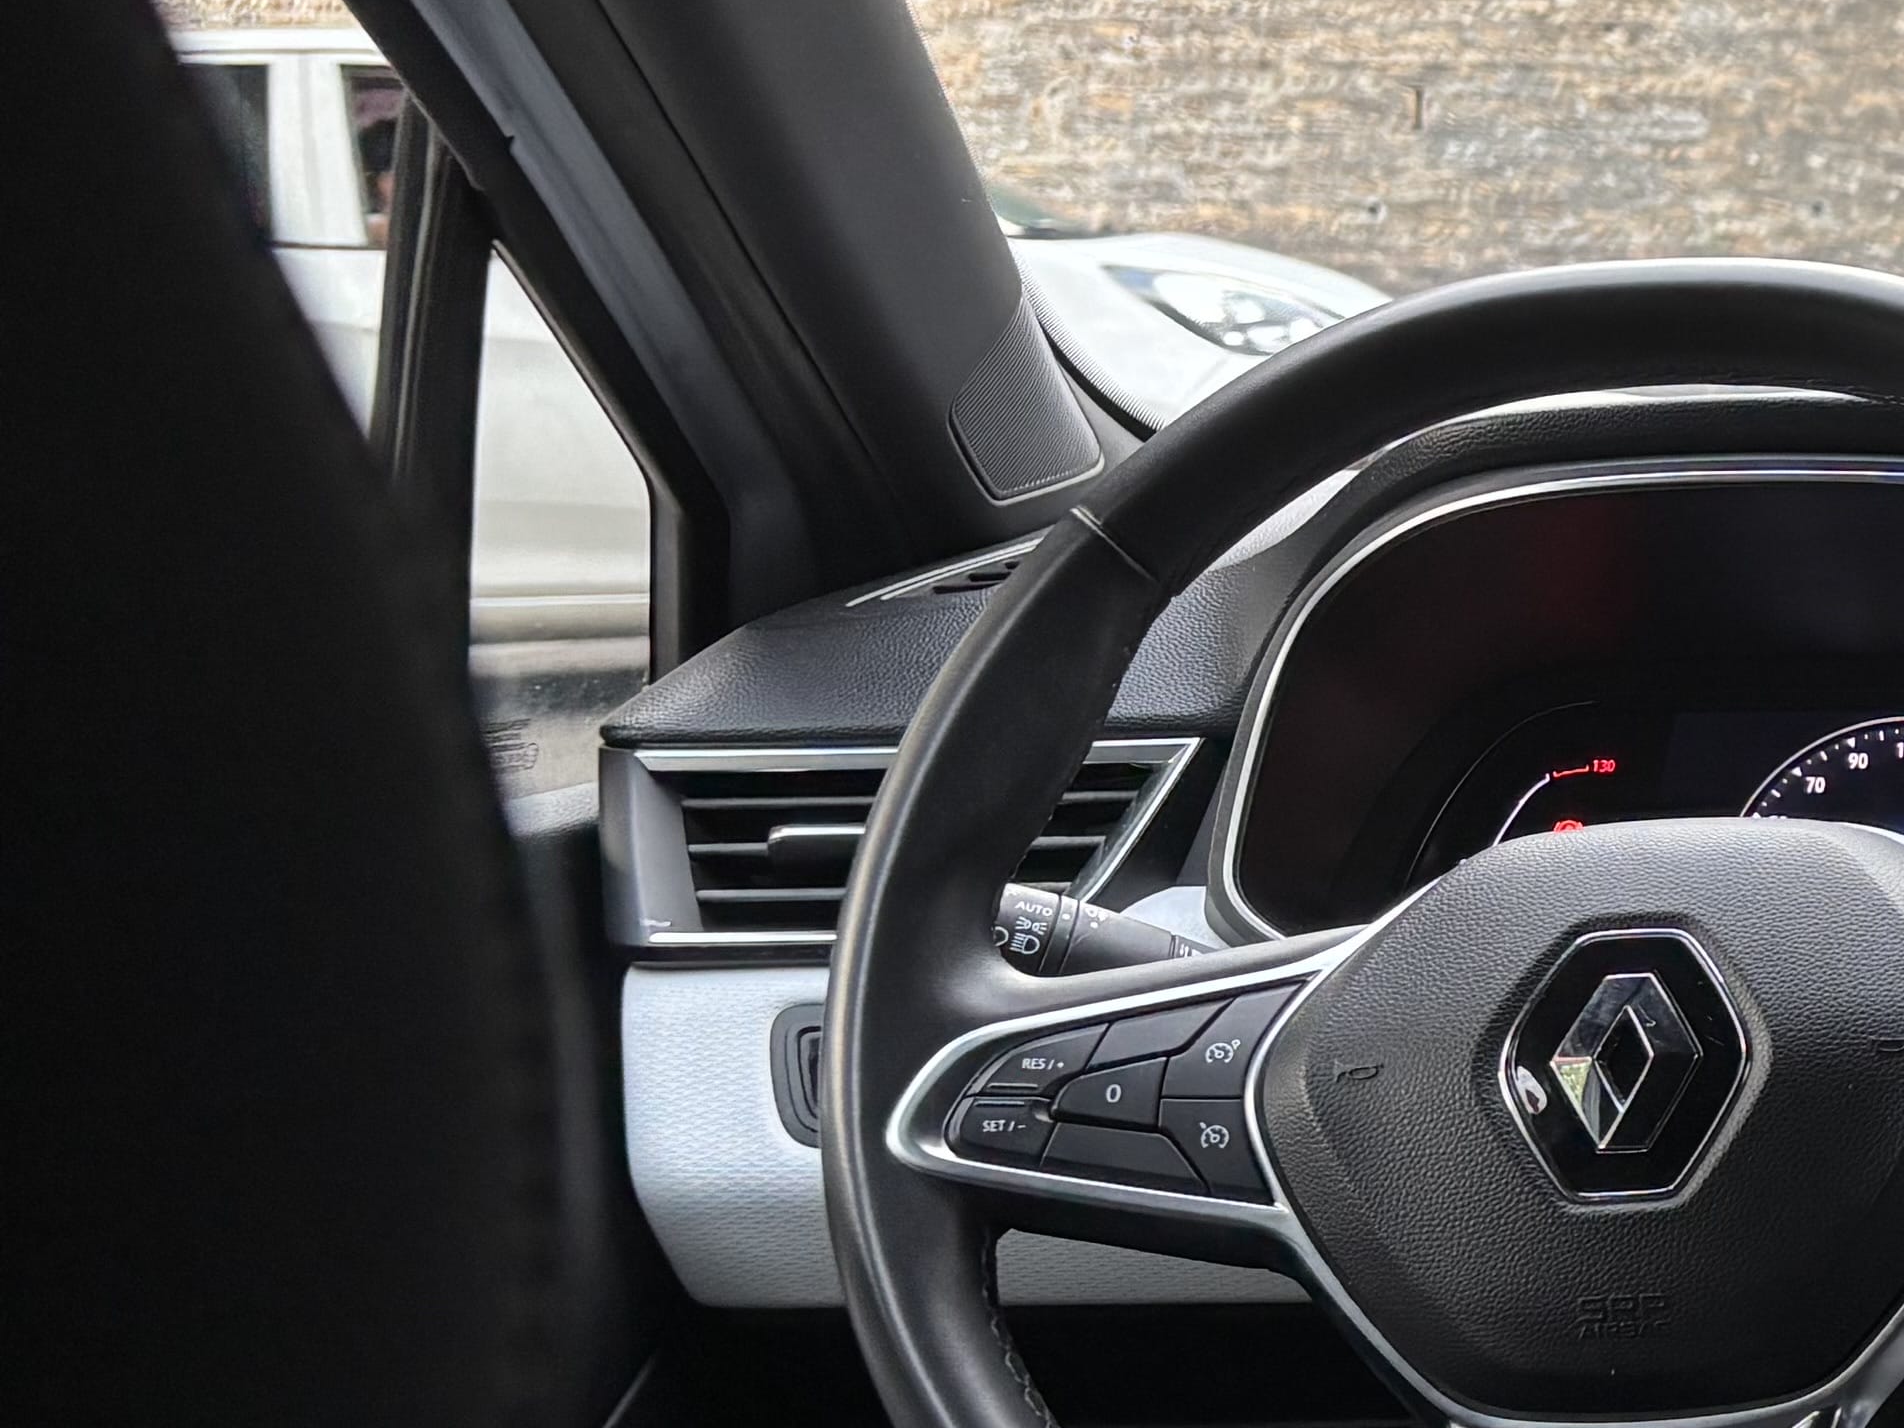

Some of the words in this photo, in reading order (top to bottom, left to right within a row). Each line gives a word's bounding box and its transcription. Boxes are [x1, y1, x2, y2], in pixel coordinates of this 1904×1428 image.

[1593, 760, 1616, 773] 130
[1848, 753, 1868, 769] 90
[1806, 777, 1825, 793] 70
[1015, 900, 1053, 917] AUTO
[1021, 1058, 1046, 1070] RES
[1105, 1084, 1122, 1103] 0
[982, 1120, 1006, 1132] SET
